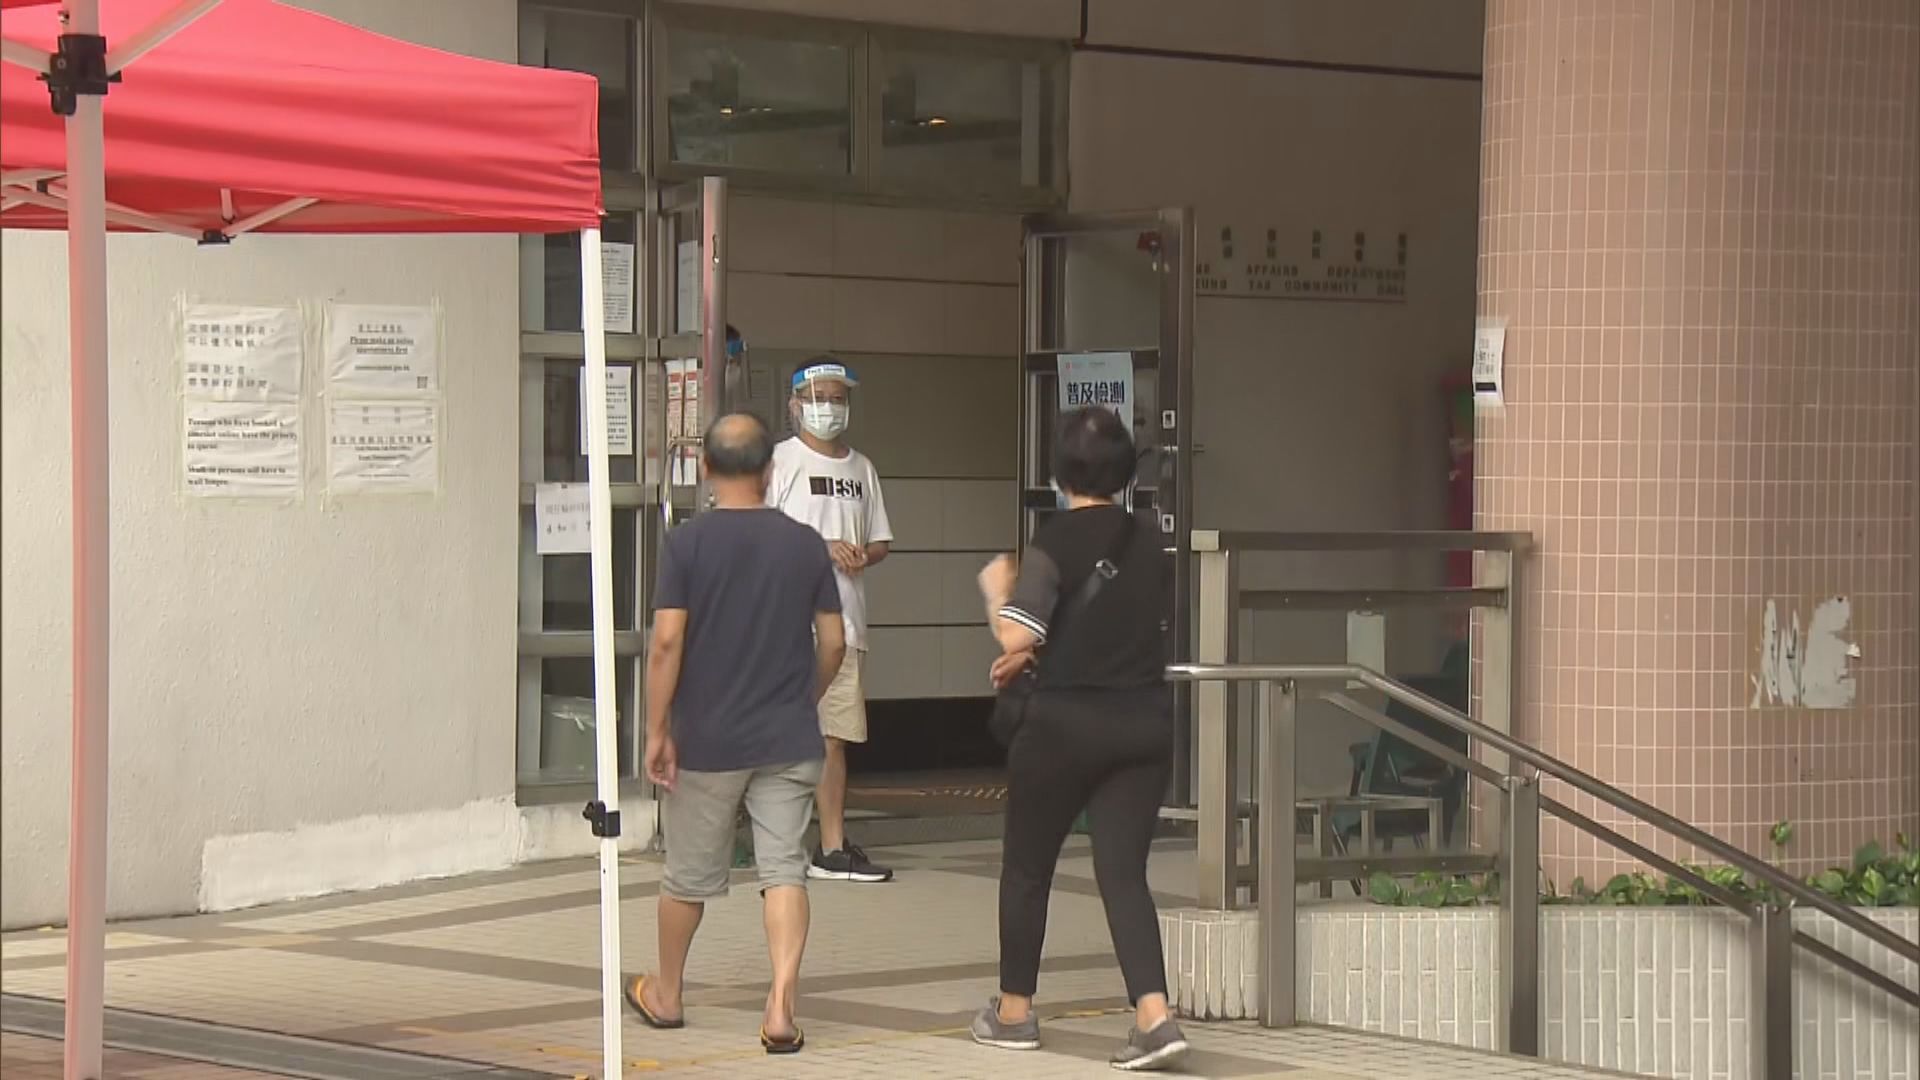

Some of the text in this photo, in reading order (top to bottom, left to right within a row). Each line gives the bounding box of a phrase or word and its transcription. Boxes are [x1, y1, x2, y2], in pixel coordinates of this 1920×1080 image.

[1246, 264, 1299, 277] AFFAIRS
[1327, 265, 1407, 280] DEPARTMENT
[1285, 280, 1359, 293] COMMUNITY
[1066, 380, 1125, 405] 普及檢測
[217, 418, 232, 427] who
[233, 418, 250, 427] have
[251, 418, 278, 428] booked
[242, 431, 258, 439] have
[259, 431, 270, 439] the
[218, 466, 245, 475] persons
[247, 465, 260, 474] will
[261, 465, 277, 474] have
[278, 465, 286, 474] to
